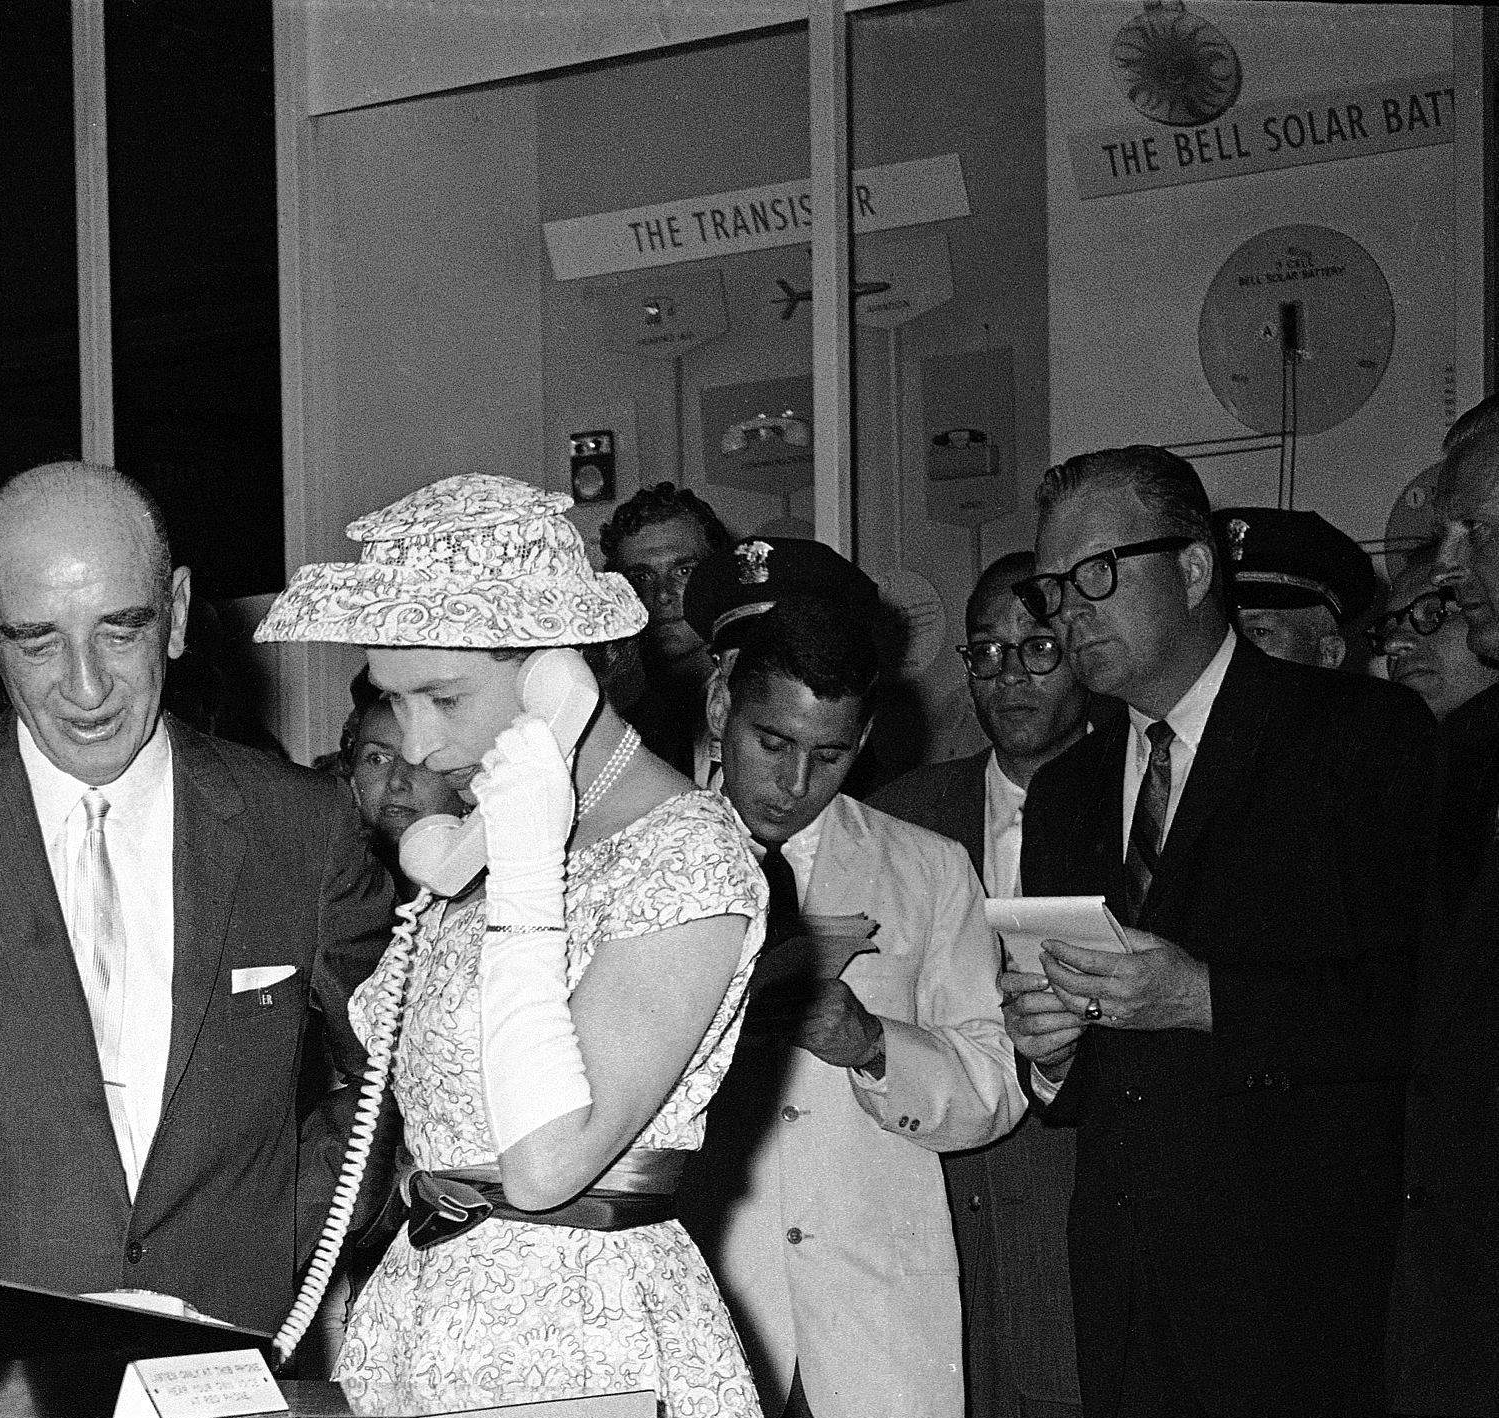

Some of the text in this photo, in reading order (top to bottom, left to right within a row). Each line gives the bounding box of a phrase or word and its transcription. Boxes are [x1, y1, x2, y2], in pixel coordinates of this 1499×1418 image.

[1103, 138, 1160, 178] THE
[1174, 124, 1251, 167] BELL
[1263, 104, 1369, 153] SOLAR
[628, 184, 876, 253] THE TRANSISR
[1265, 270, 1299, 283] SOLAR
[1301, 265, 1346, 281] BATTERY
